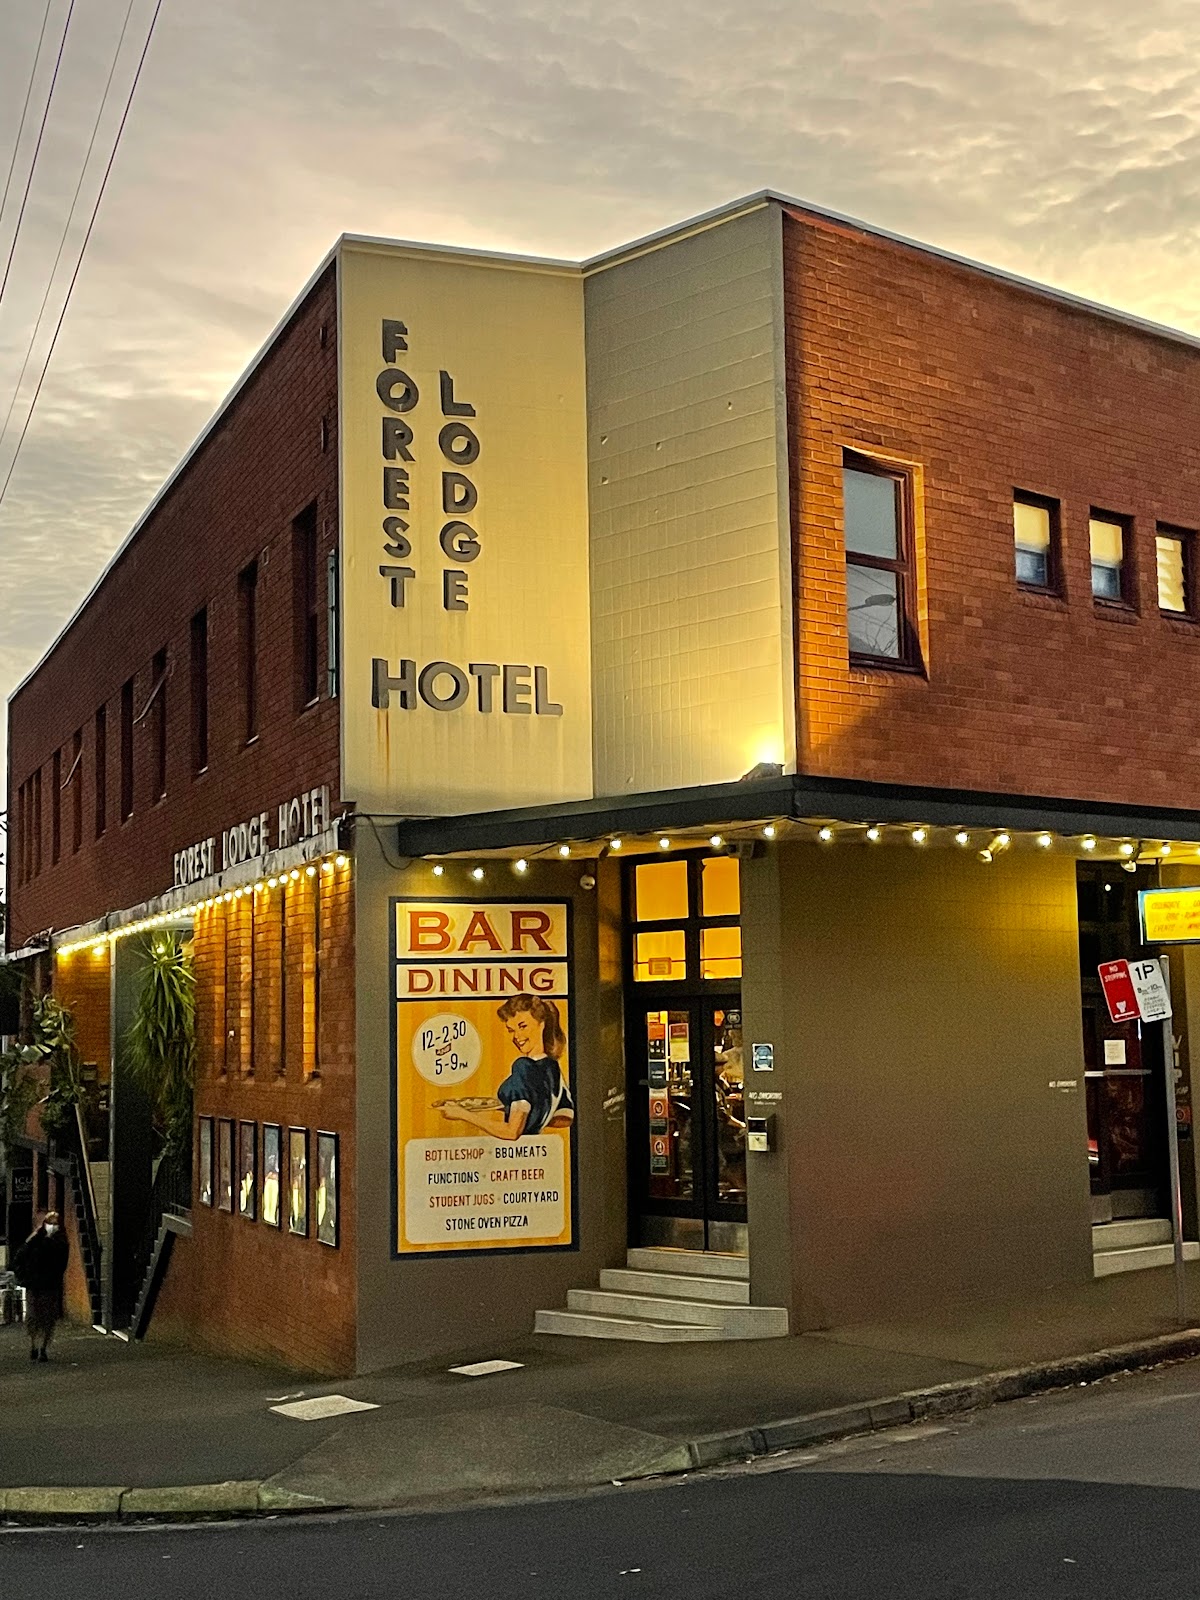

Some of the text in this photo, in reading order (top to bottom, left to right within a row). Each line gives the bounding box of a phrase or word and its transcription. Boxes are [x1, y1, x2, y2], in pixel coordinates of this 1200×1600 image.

[376, 319, 419, 608] FOREST
[438, 370, 482, 611] LODGE
[371, 658, 564, 717] HOTEL
[173, 785, 330, 887] FOREST LODGE HOTEL
[408, 911, 554, 952] BAR
[407, 968, 555, 993] DINING
[1135, 963, 1154, 980] 1P
[422, 1020, 466, 1051] 12-2.30
[425, 1145, 547, 1162] BOTTLESHOP BBQ MEATS
[428, 1168, 545, 1185] FUNCTIONS CRAFT BEER
[429, 1190, 559, 1208] STUDENT JUGS COURTYARD
[445, 1215, 529, 1231] STONE OVEN PIZZA
